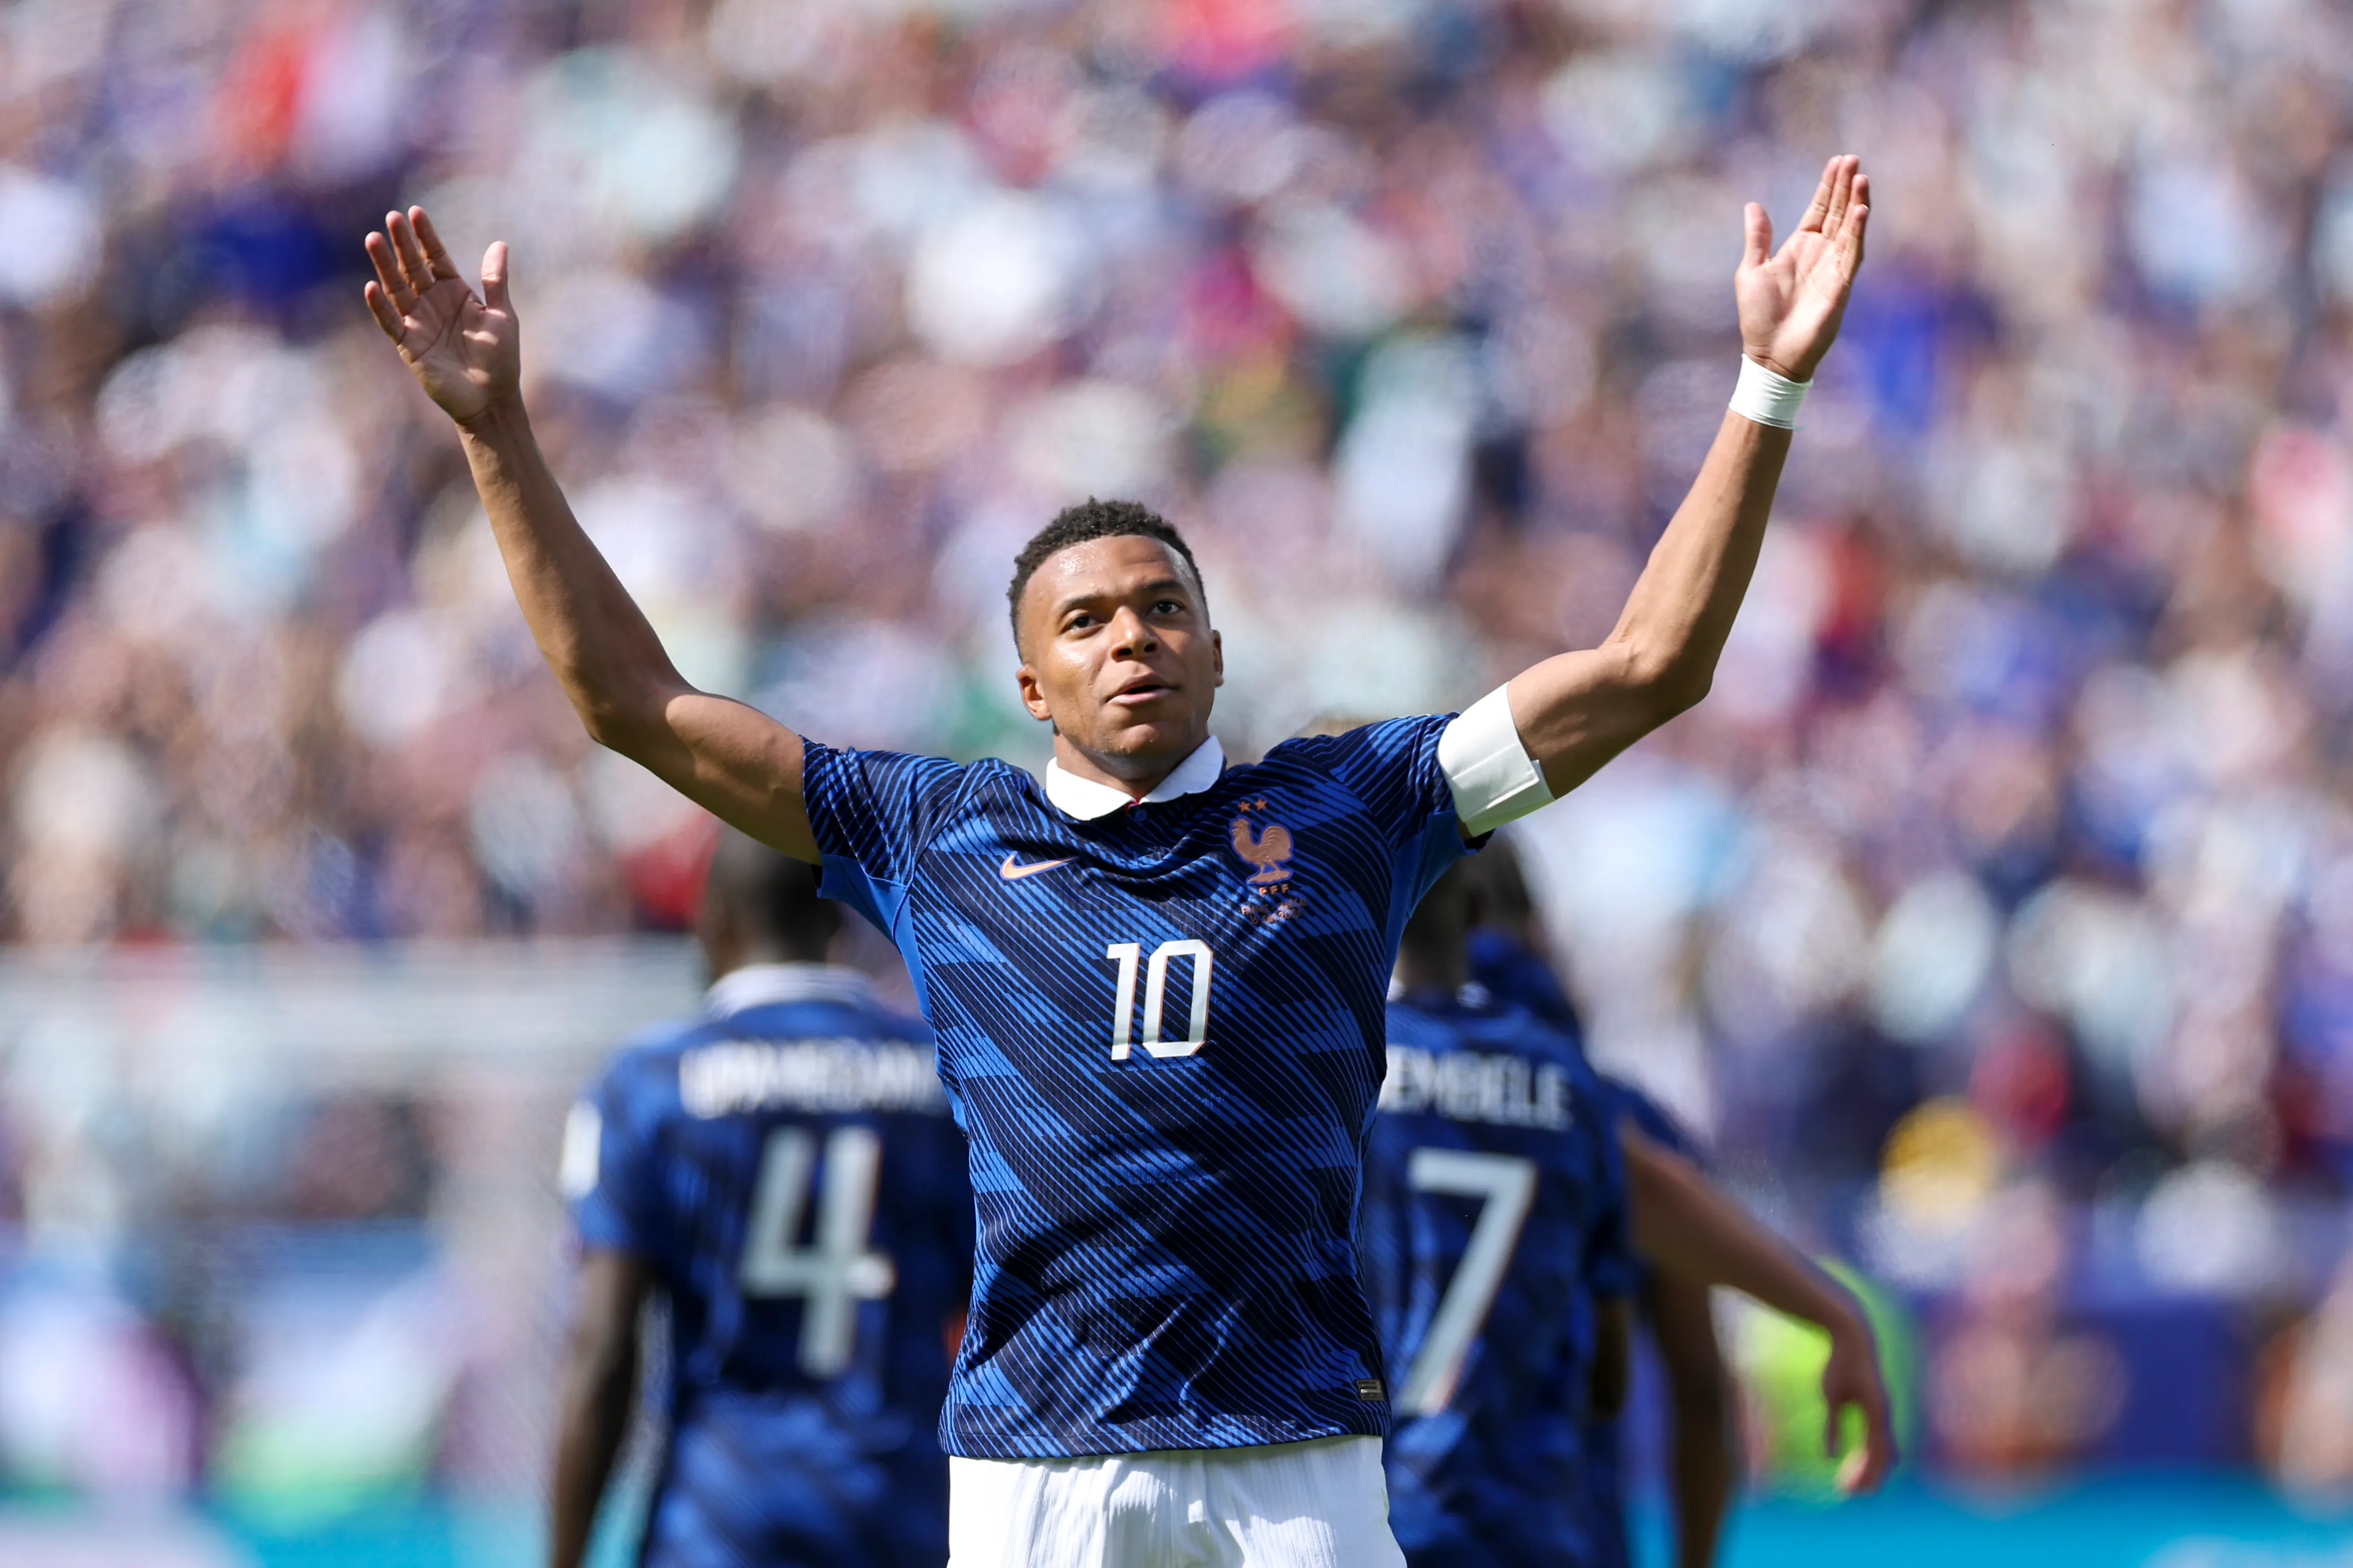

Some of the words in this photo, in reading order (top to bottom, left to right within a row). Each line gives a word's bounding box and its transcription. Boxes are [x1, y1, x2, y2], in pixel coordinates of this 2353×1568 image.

[1106, 939, 1214, 1060] 10
[1377, 1044, 1573, 1131] EMBELE
[741, 1125, 897, 1379] 4
[1400, 1146, 1539, 1417] 7
